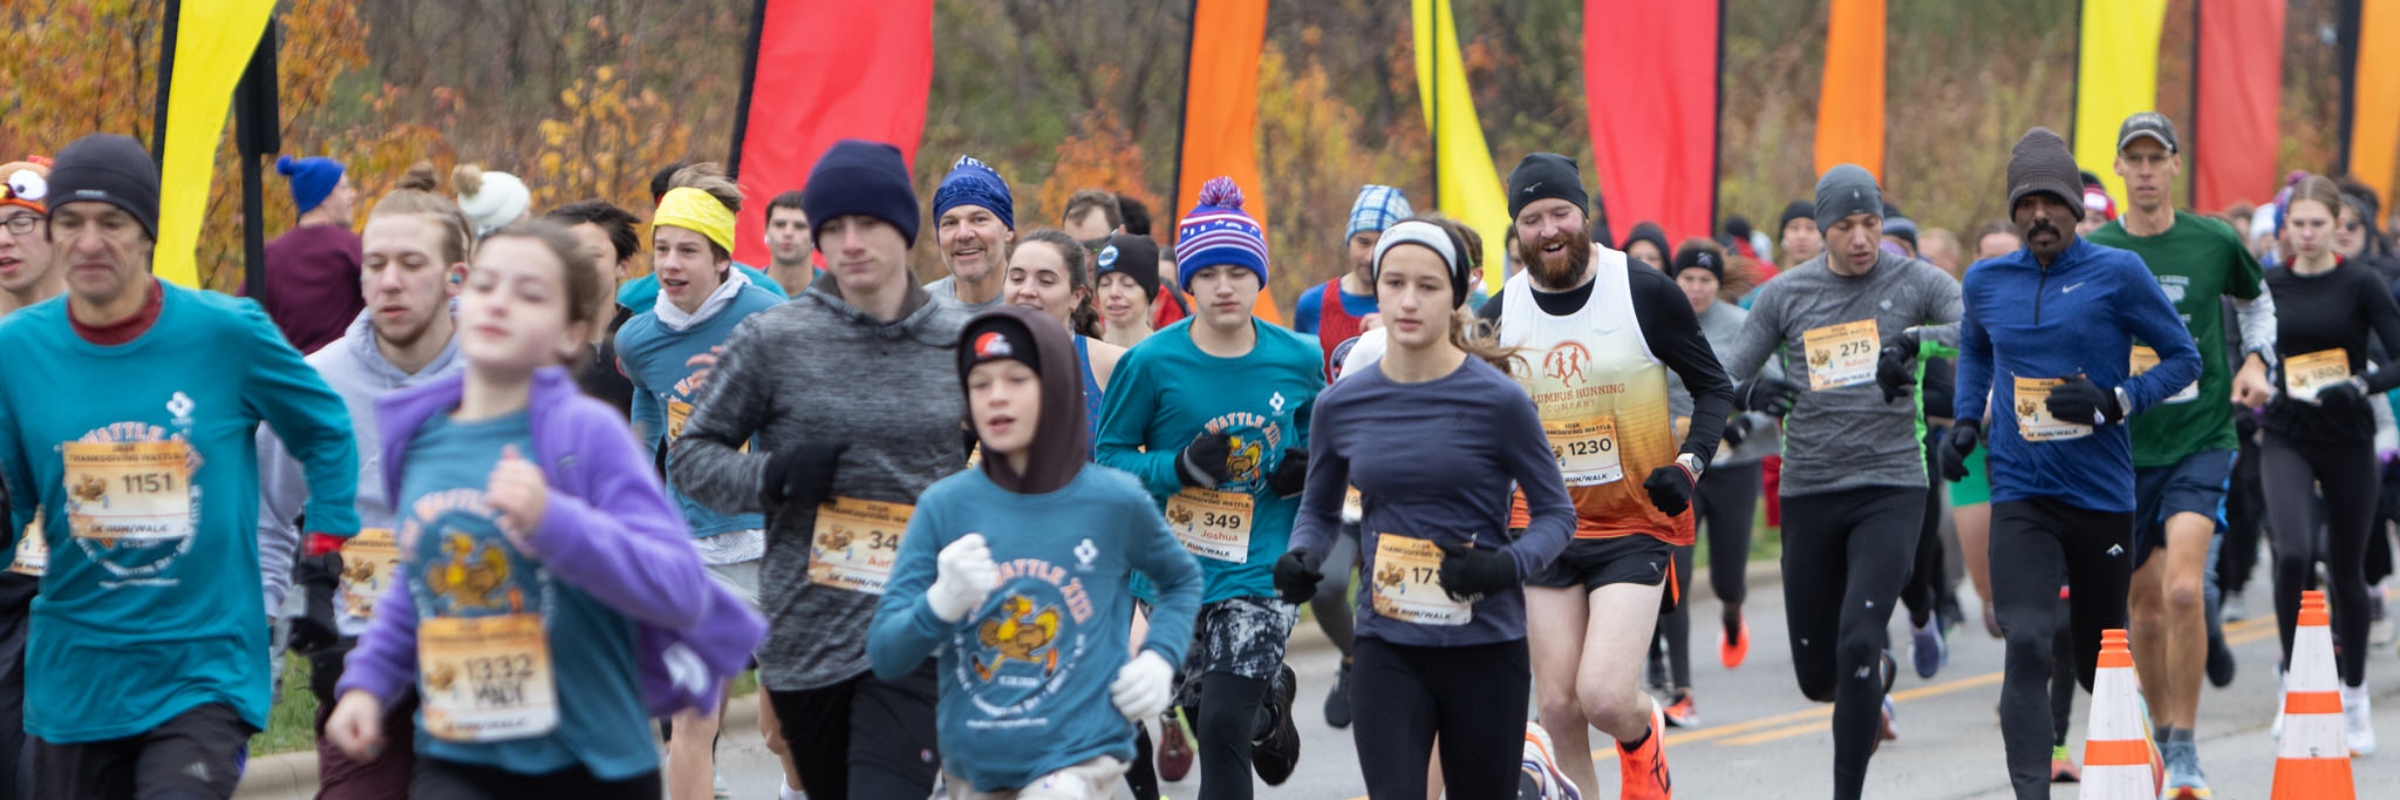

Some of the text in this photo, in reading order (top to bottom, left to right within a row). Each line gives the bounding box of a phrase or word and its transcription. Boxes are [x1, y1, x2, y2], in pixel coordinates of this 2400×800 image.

[1840, 340, 1871, 357] 275
[1575, 383, 1625, 400] RUNNING
[1546, 400, 1596, 413] COMPANY
[1204, 411, 1266, 435] WATTLE
[1585, 423, 1612, 434] WATTLE
[2037, 428, 2077, 438] RUN/WALK
[1567, 437, 1612, 456] 1230
[69, 452, 180, 463] THANKSGIVING WATTLE
[121, 472, 173, 494] 1151
[1565, 473, 1608, 483] RUN/WALK
[1222, 500, 1251, 509] WATTLE
[1203, 511, 1241, 530] 349
[107, 523, 168, 534] RUN/WALK
[1201, 529, 1239, 543] Joshua
[1187, 541, 1231, 558] RUN/WALK
[844, 576, 884, 588] RUN/W
[1412, 566, 1442, 586] 17
[1401, 608, 1451, 620] RUN/WALK
[465, 652, 534, 682] 1332
